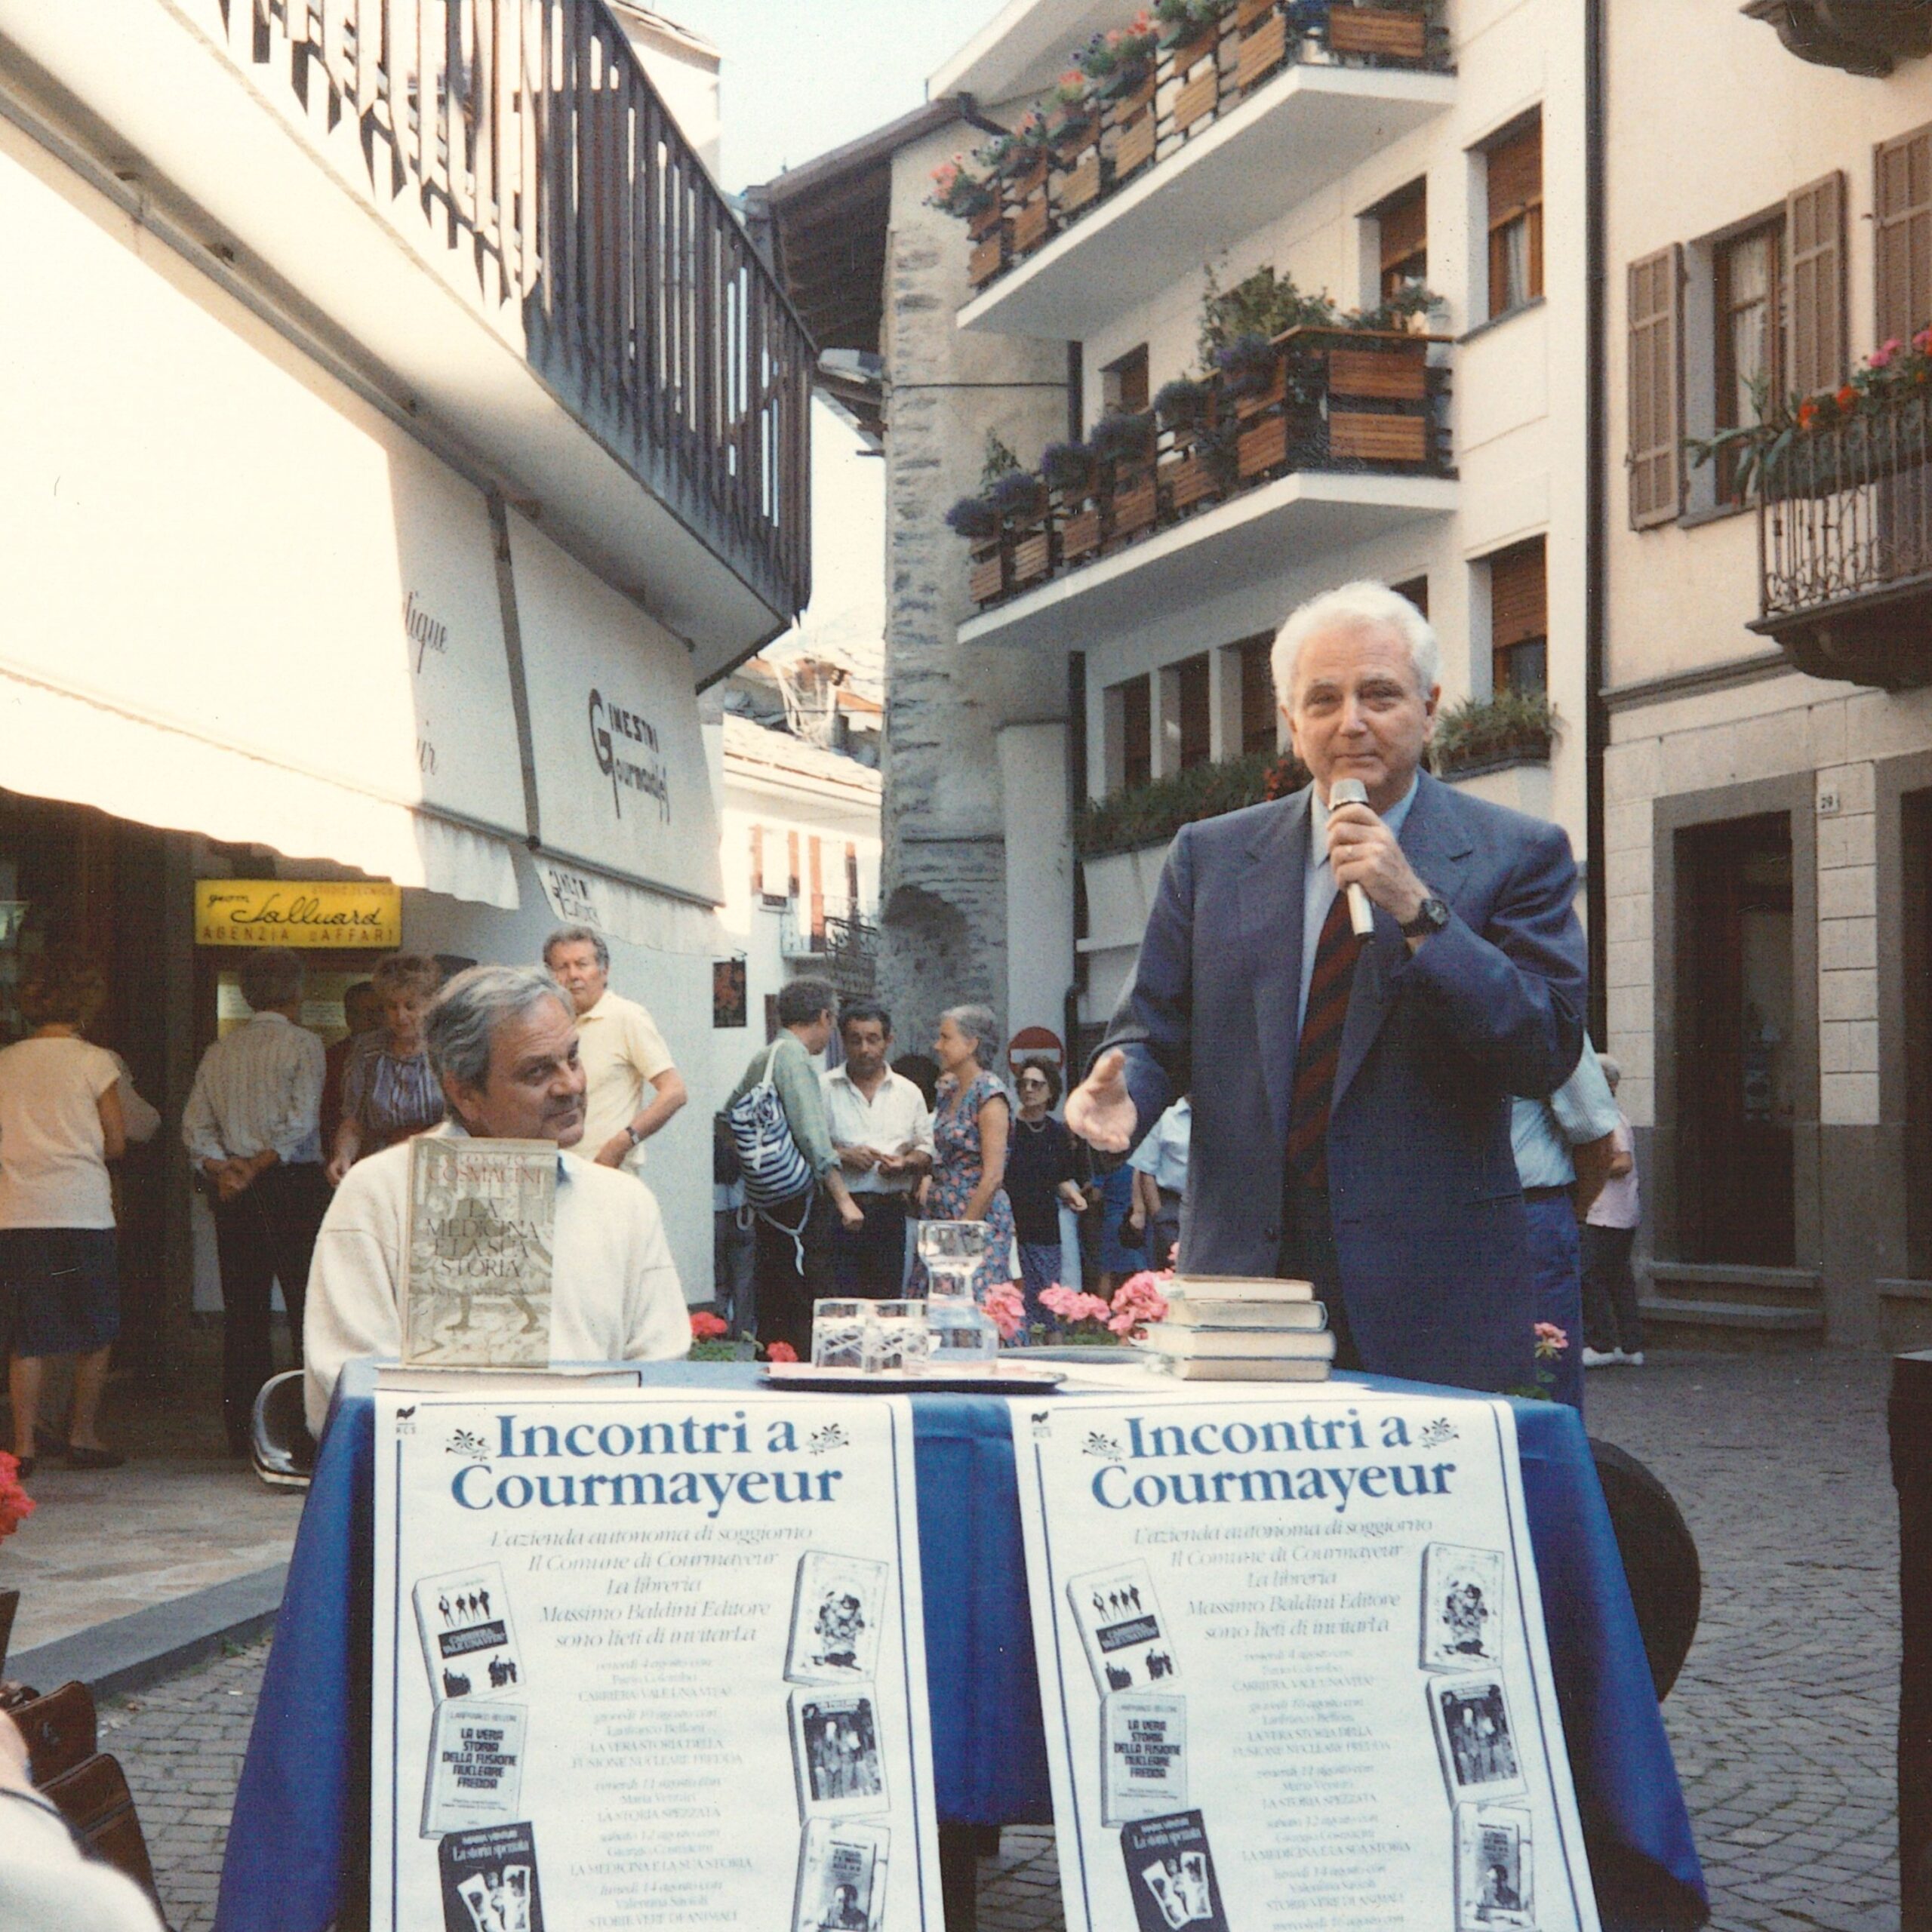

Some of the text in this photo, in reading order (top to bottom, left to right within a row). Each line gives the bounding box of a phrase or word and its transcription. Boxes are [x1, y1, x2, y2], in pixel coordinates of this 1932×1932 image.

[202, 926, 288, 941] AGENZIA
[426, 1219, 539, 1239] MEDICINA
[441, 1260, 521, 1278] STORIA
[495, 1408, 800, 1460] Incontri a
[1124, 1408, 1413, 1460] Incontri a
[451, 1463, 844, 1519] Courmayeur
[1091, 1460, 1457, 1513] Courmayeur
[586, 1526, 691, 1545] autonoma
[694, 1523, 715, 1543] di
[717, 1524, 814, 1546] soggiorno
[1223, 1522, 1322, 1541] autonoma
[1324, 1519, 1343, 1536] di
[1345, 1518, 1433, 1538] soggiorno
[528, 1549, 780, 1573] Il Comune di Courmayeur
[1187, 1549, 1266, 1566] Comune
[1270, 1546, 1288, 1563] di
[1291, 1543, 1404, 1564] Courmayeur
[605, 1575, 703, 1596] La libreria
[1247, 1570, 1337, 1588] La libreria
[539, 1600, 771, 1624] Massimo Baldini Editore
[1186, 1592, 1401, 1617] Massimo Baldini Editore
[554, 1632, 604, 1650] sono
[607, 1627, 645, 1647] lieti
[652, 1626, 672, 1646] di
[1204, 1625, 1250, 1641] sono
[1289, 1620, 1307, 1636] di
